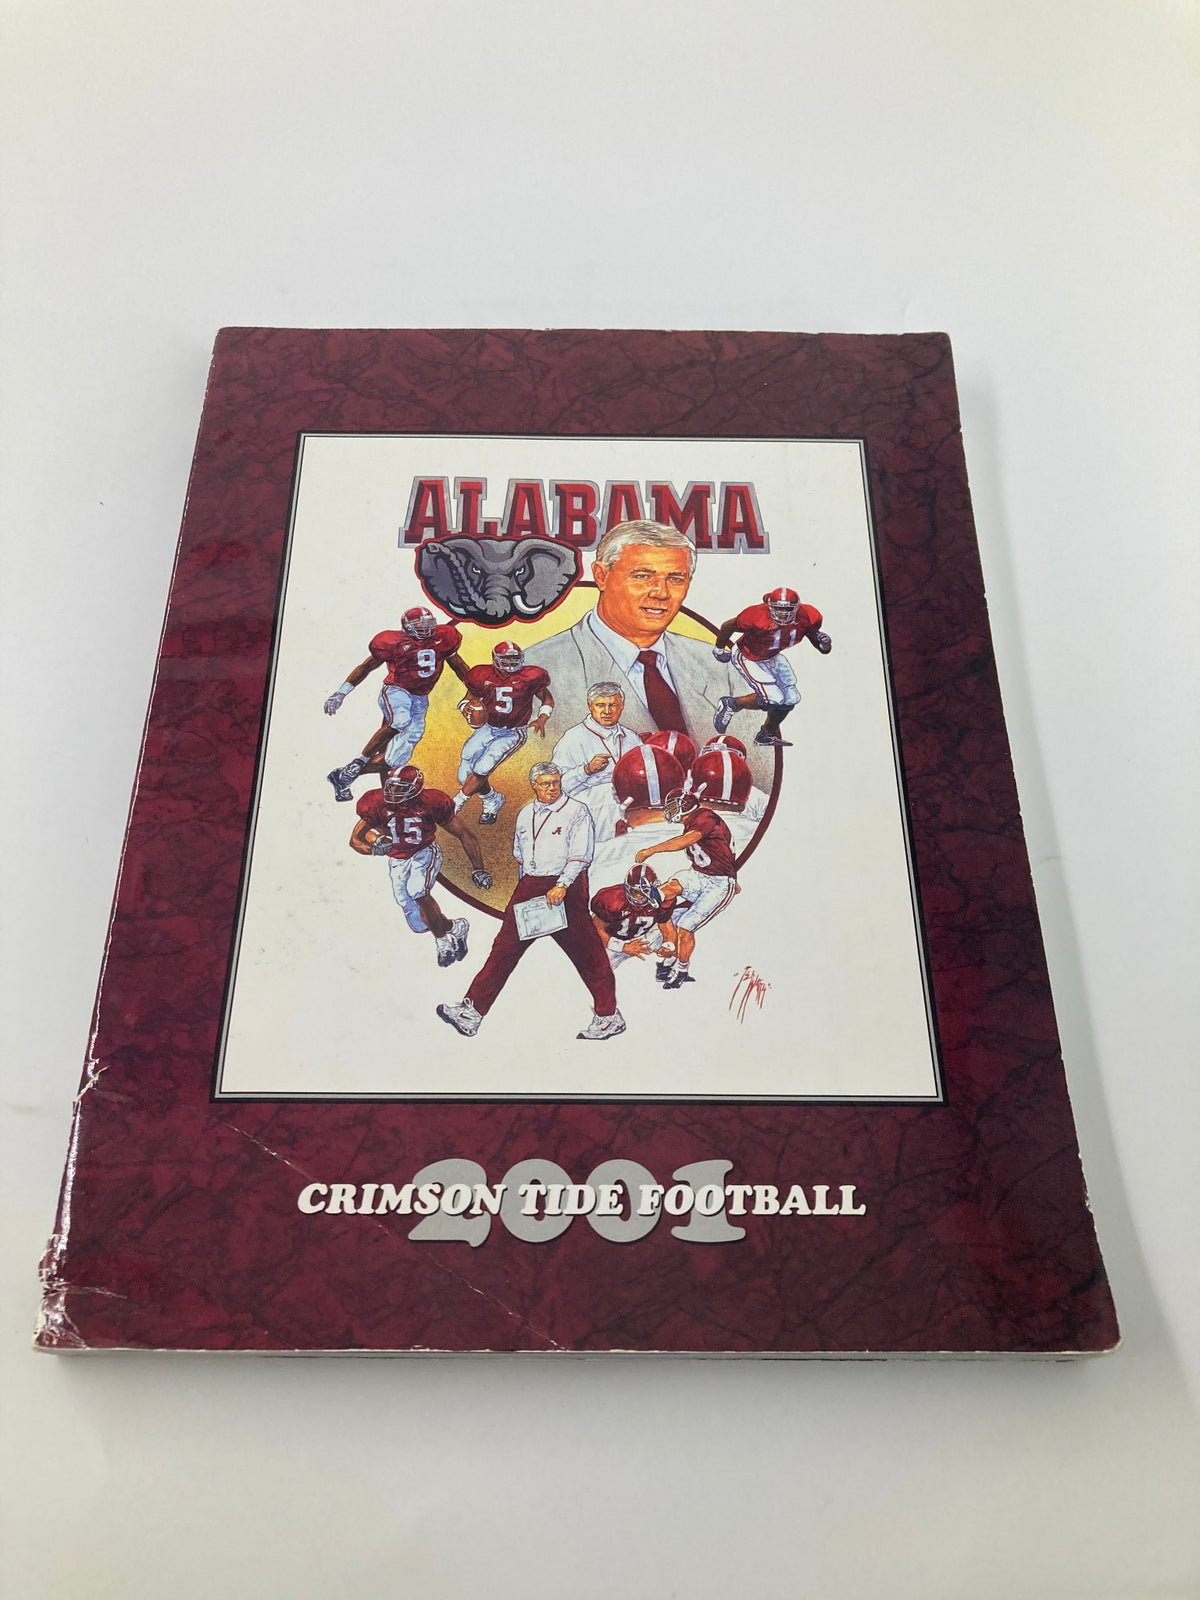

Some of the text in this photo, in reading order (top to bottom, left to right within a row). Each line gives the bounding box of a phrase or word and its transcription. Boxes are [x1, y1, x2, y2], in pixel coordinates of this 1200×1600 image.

[398, 476, 770, 554] ALABAMA
[417, 649, 435, 678] 9
[495, 687, 513, 713] 5
[387, 817, 422, 844] 15
[617, 916, 654, 937] 17
[297, 1183, 866, 1216] CRIMSON TIDE FOOTBALL
[408, 1158, 746, 1247] 2001
